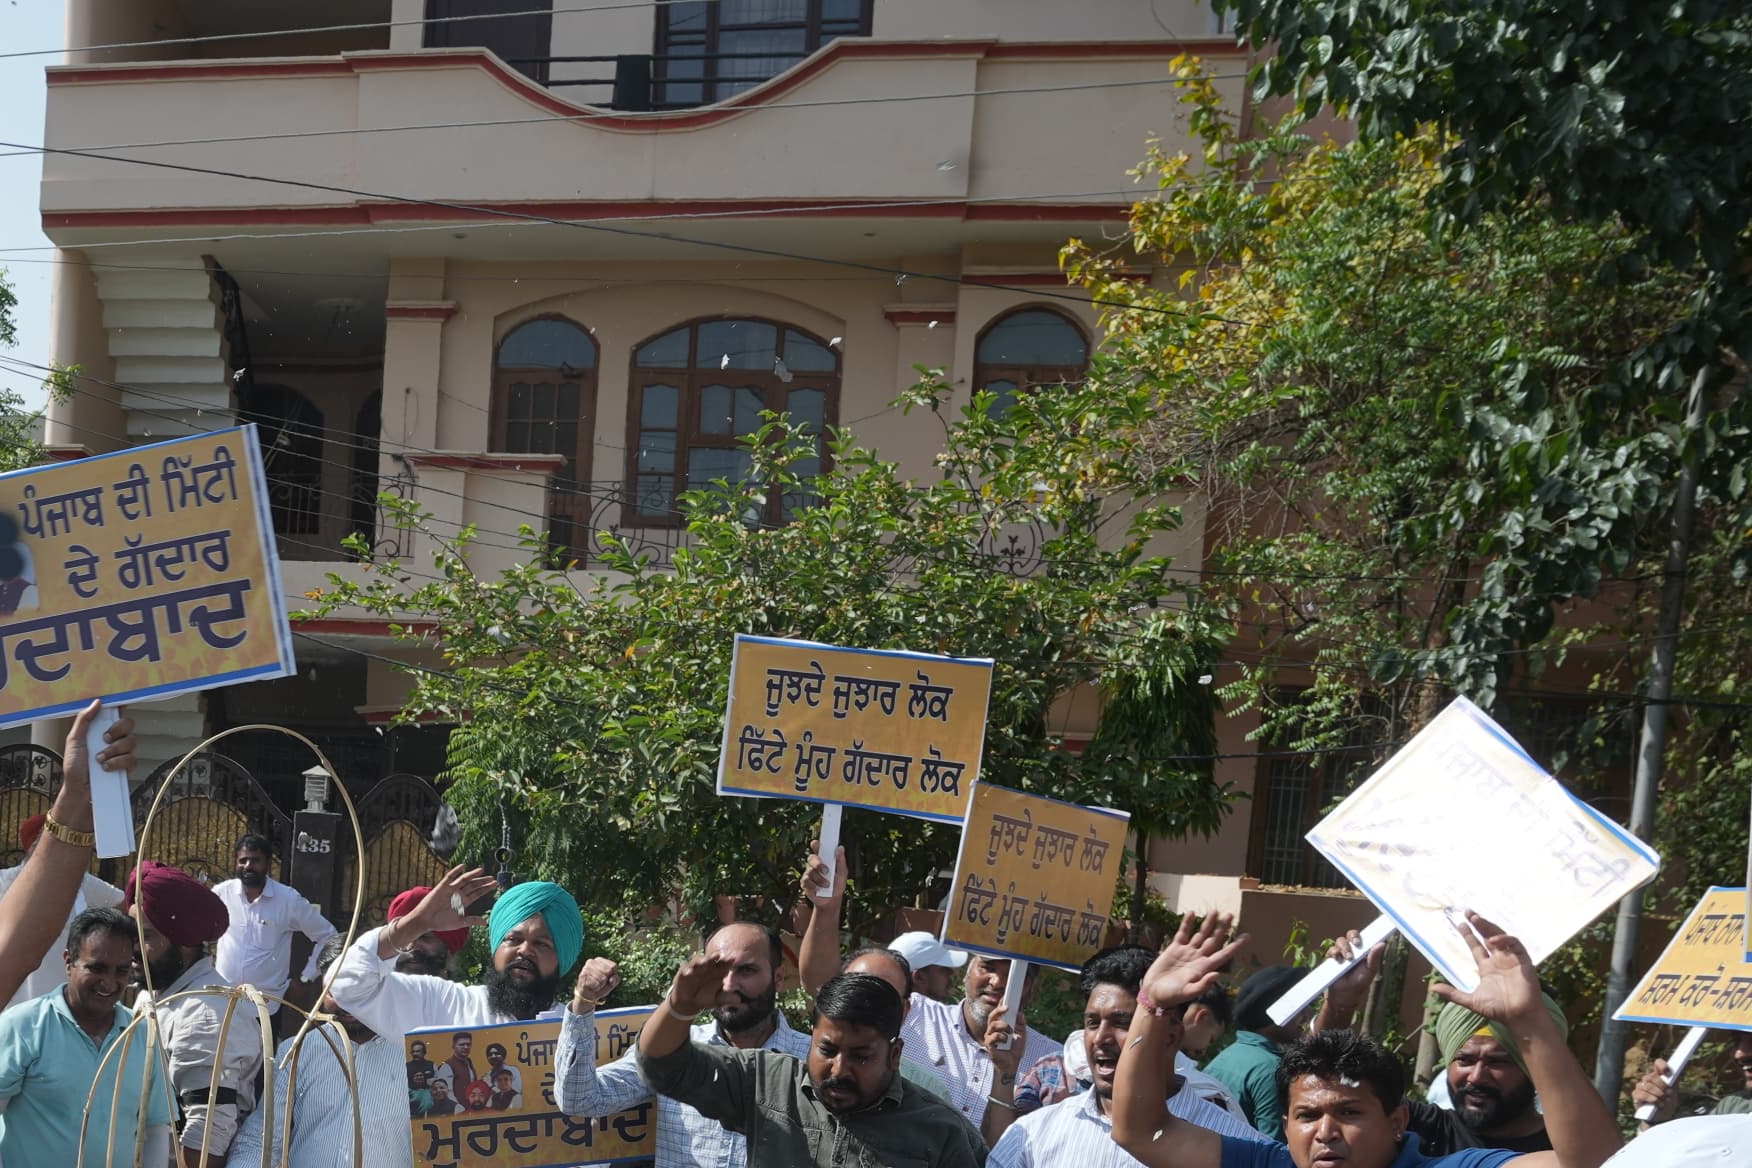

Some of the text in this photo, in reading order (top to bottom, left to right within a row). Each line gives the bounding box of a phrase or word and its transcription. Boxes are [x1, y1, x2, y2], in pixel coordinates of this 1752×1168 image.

[18, 446, 238, 538] ਪੰਜਾਬ ਦੀ ਮਿੱਟੀ
[64, 530, 231, 598] ਦੇ ਗੱਦਾਰ
[766, 661, 825, 716] ਜੂਝਦੇ
[909, 669, 953, 721] ਲੋਕ
[738, 725, 965, 796] ਫਿੱਟੇ ਮੂੰਹ ਗੱਦਾਰ ਲੋਕ
[1080, 824, 1109, 875] ਲੋਕ
[1030, 890, 1076, 943] ਗੱਦਾਰ
[1077, 898, 1107, 949] ਲੋਕ
[516, 1031, 558, 1067] ਪੰਜਾ
